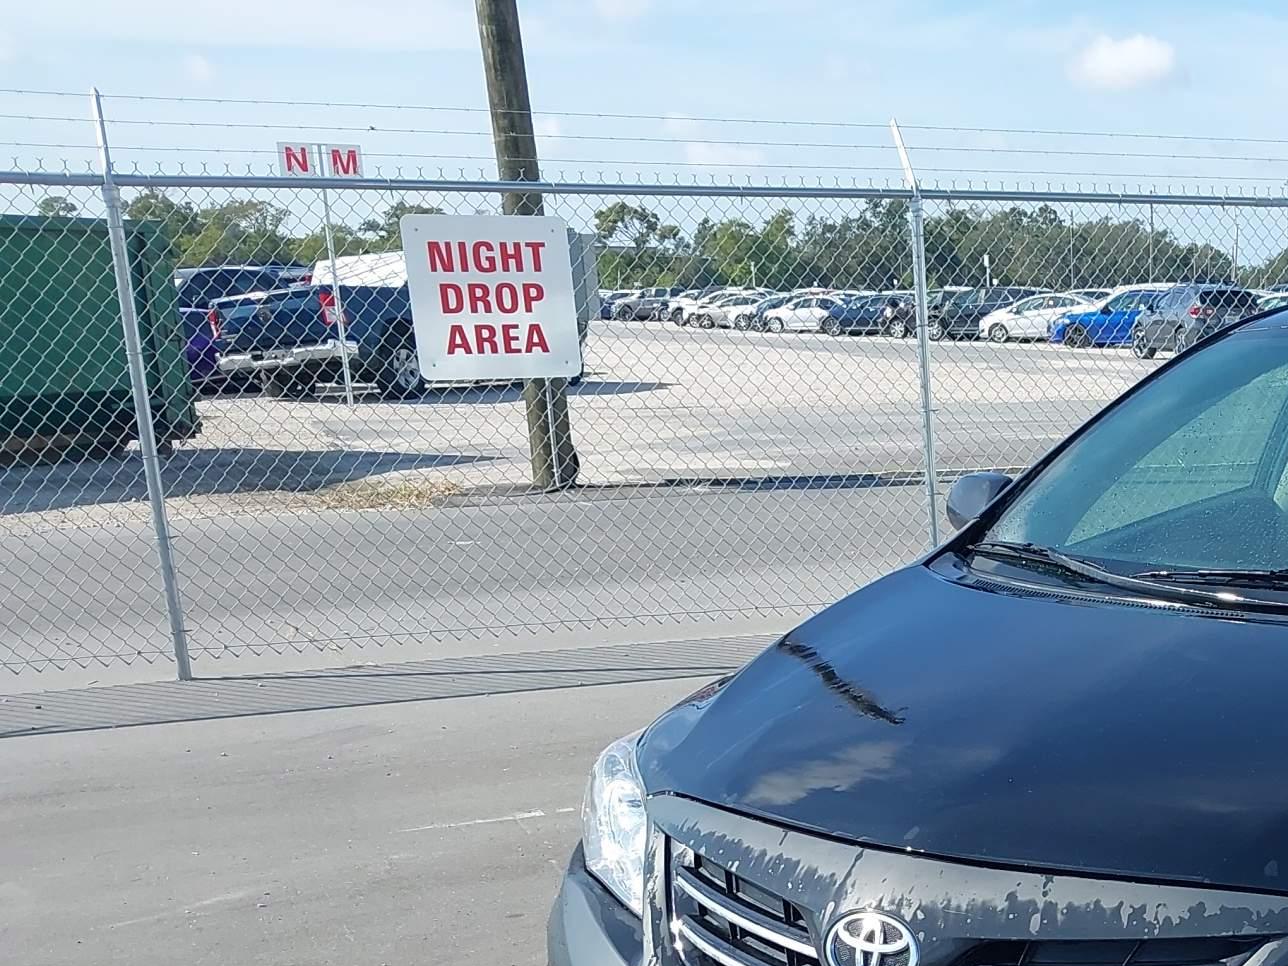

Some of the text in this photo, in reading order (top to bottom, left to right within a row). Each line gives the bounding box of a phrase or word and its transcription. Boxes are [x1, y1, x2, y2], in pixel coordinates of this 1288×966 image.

[284, 146, 358, 175] N M
[426, 240, 546, 273] NIGHT
[438, 282, 545, 315] DROP
[446, 323, 551, 356] AREA
